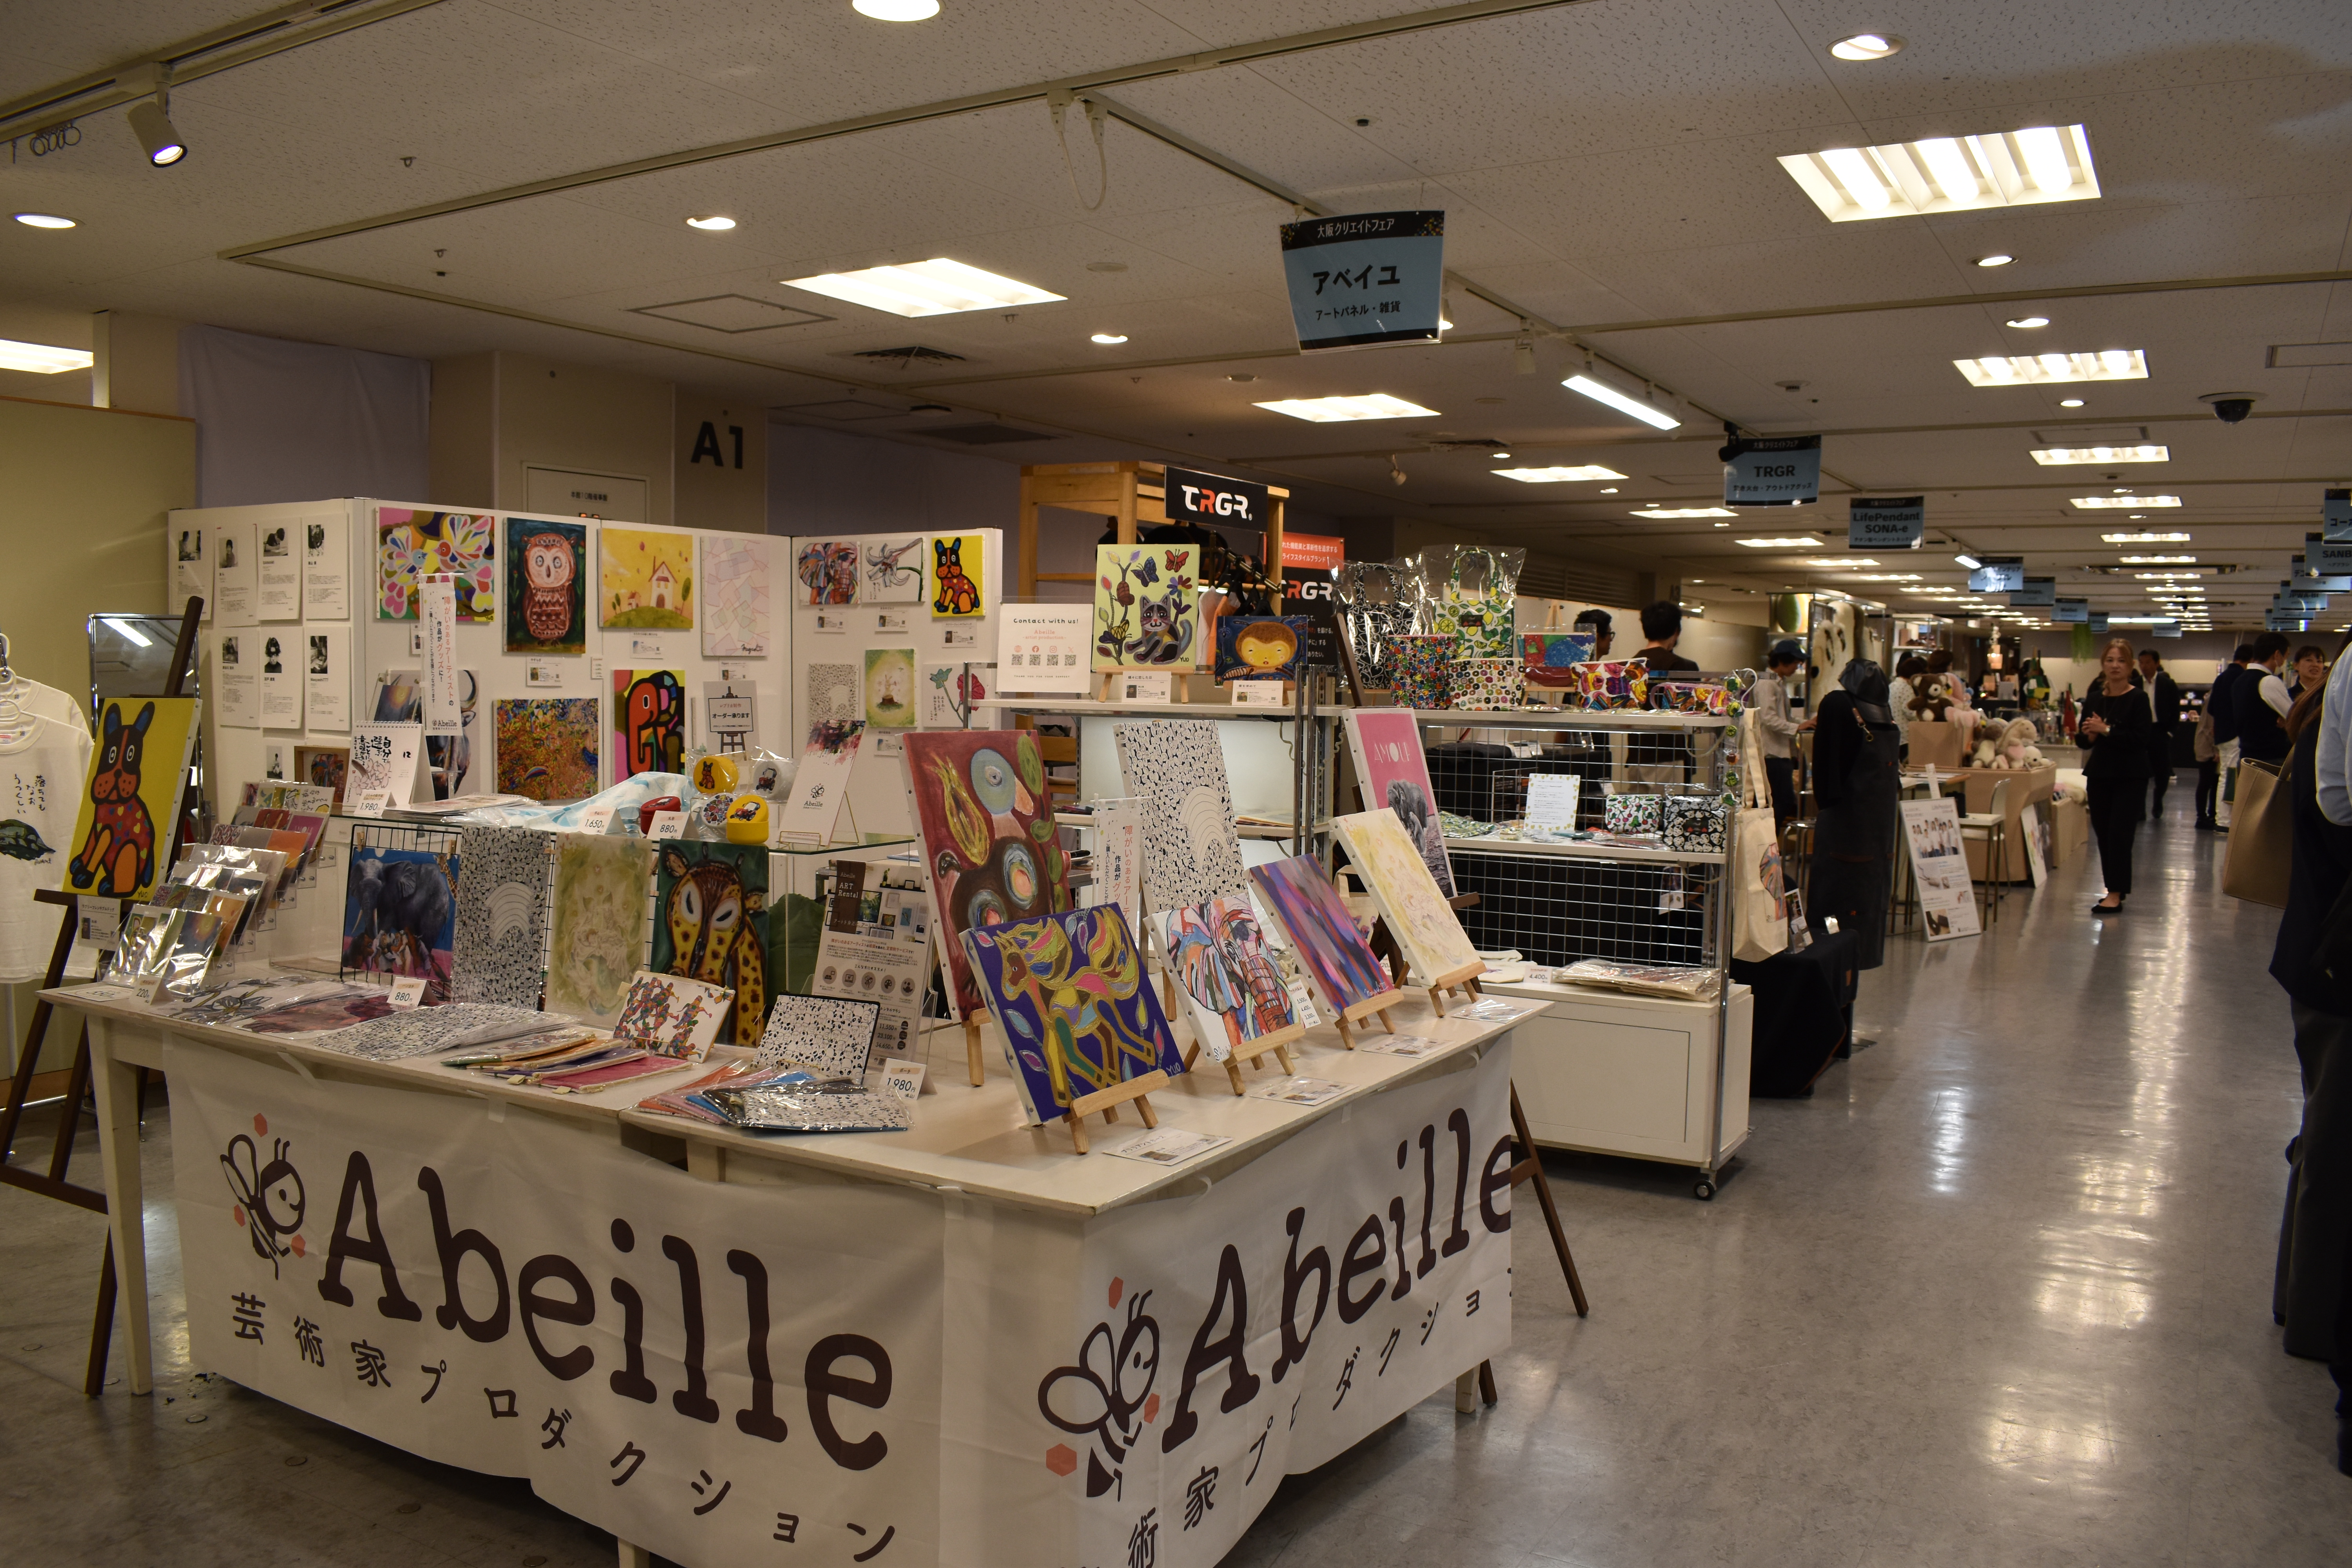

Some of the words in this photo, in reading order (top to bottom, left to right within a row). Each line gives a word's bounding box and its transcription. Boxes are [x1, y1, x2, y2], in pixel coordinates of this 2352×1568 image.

[1317, 218, 1395, 239] 大阪クリエイトフェア
[1313, 264, 1400, 296] アベイユ
[1316, 301, 1401, 321] アートパネル・雑貨
[690, 421, 743, 469] A1
[1753, 465, 1795, 477] TRGR
[1181, 485, 1249, 519] TRGR
[1853, 512, 1920, 522] LifePendant
[1865, 524, 1908, 533] SONA-e
[14, 773, 26, 814] うつくしい
[26, 784, 36, 806] なお
[36, 775, 46, 812] 落ちても
[584, 818, 604, 829] 1,650円
[660, 824, 677, 833] 880円
[838, 889, 858, 898] Rental
[395, 992, 413, 1002] 880円
[887, 1077, 916, 1093] 1980円
[1161, 1108, 1511, 1454] Abeille
[317, 1150, 893, 1471] Abeille
[230, 1290, 896, 1563] 芸術家プロダクション
